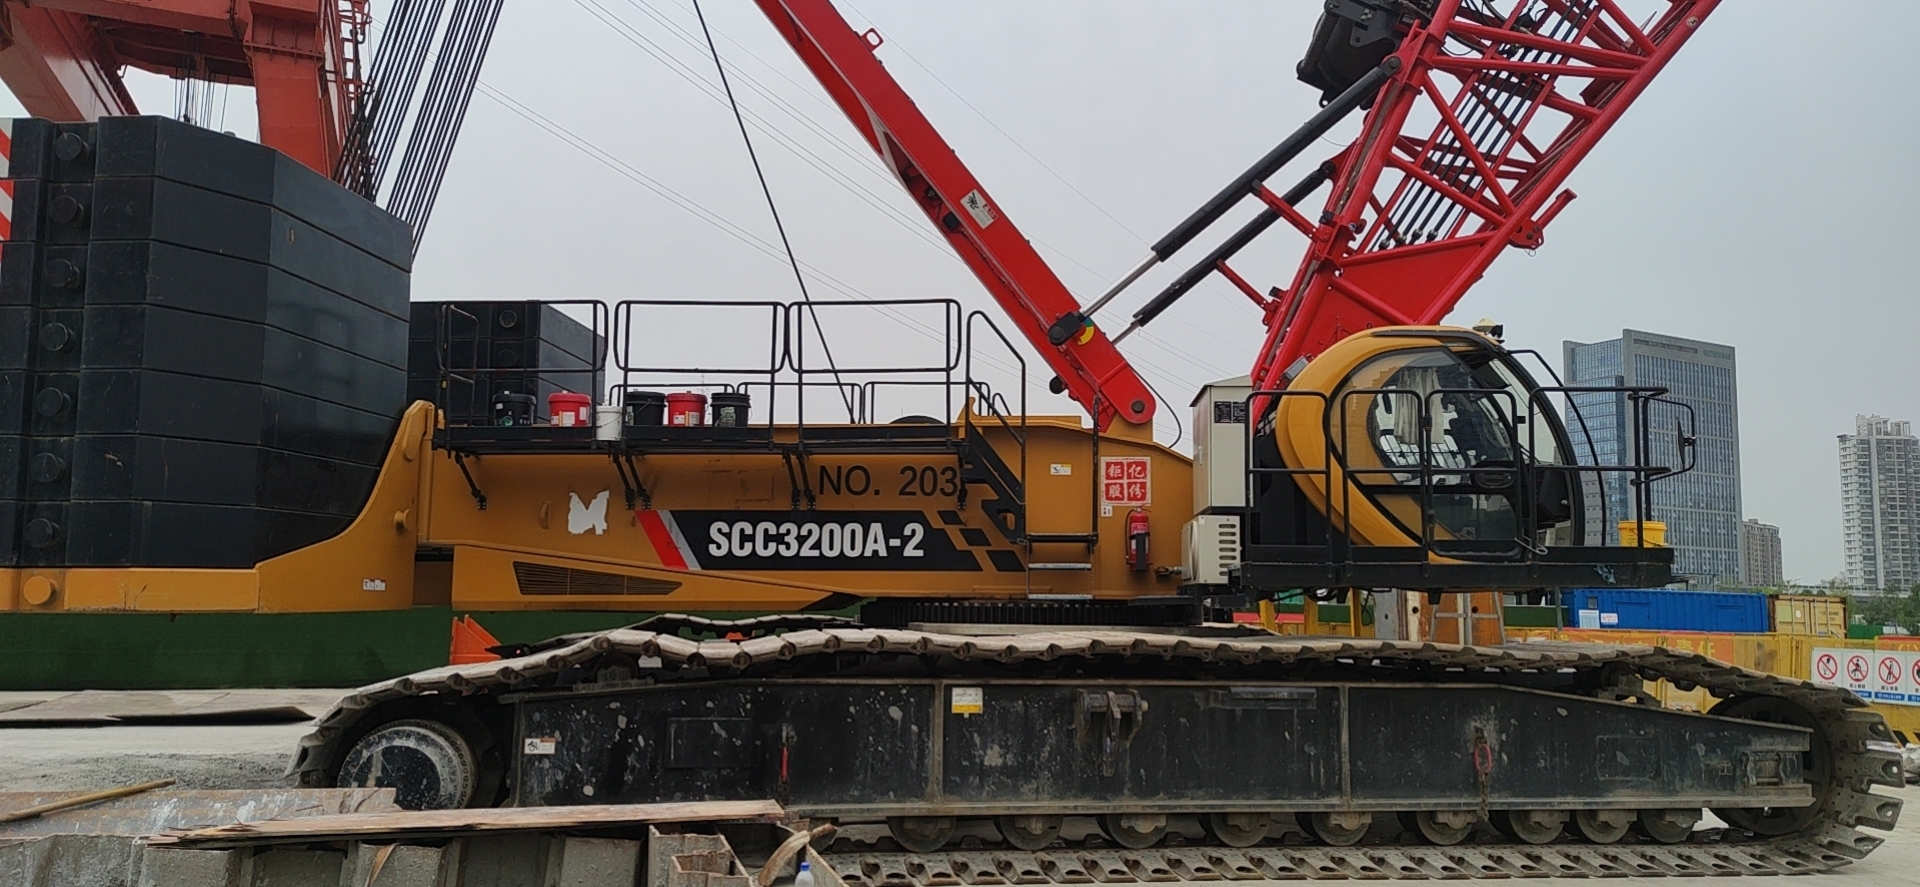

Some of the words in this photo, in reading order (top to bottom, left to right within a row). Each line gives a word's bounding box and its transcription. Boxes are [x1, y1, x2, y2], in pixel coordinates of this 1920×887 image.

[819, 465, 881, 496] NO.
[898, 466, 958, 497] 203
[708, 520, 925, 558] SCC3200A-2
